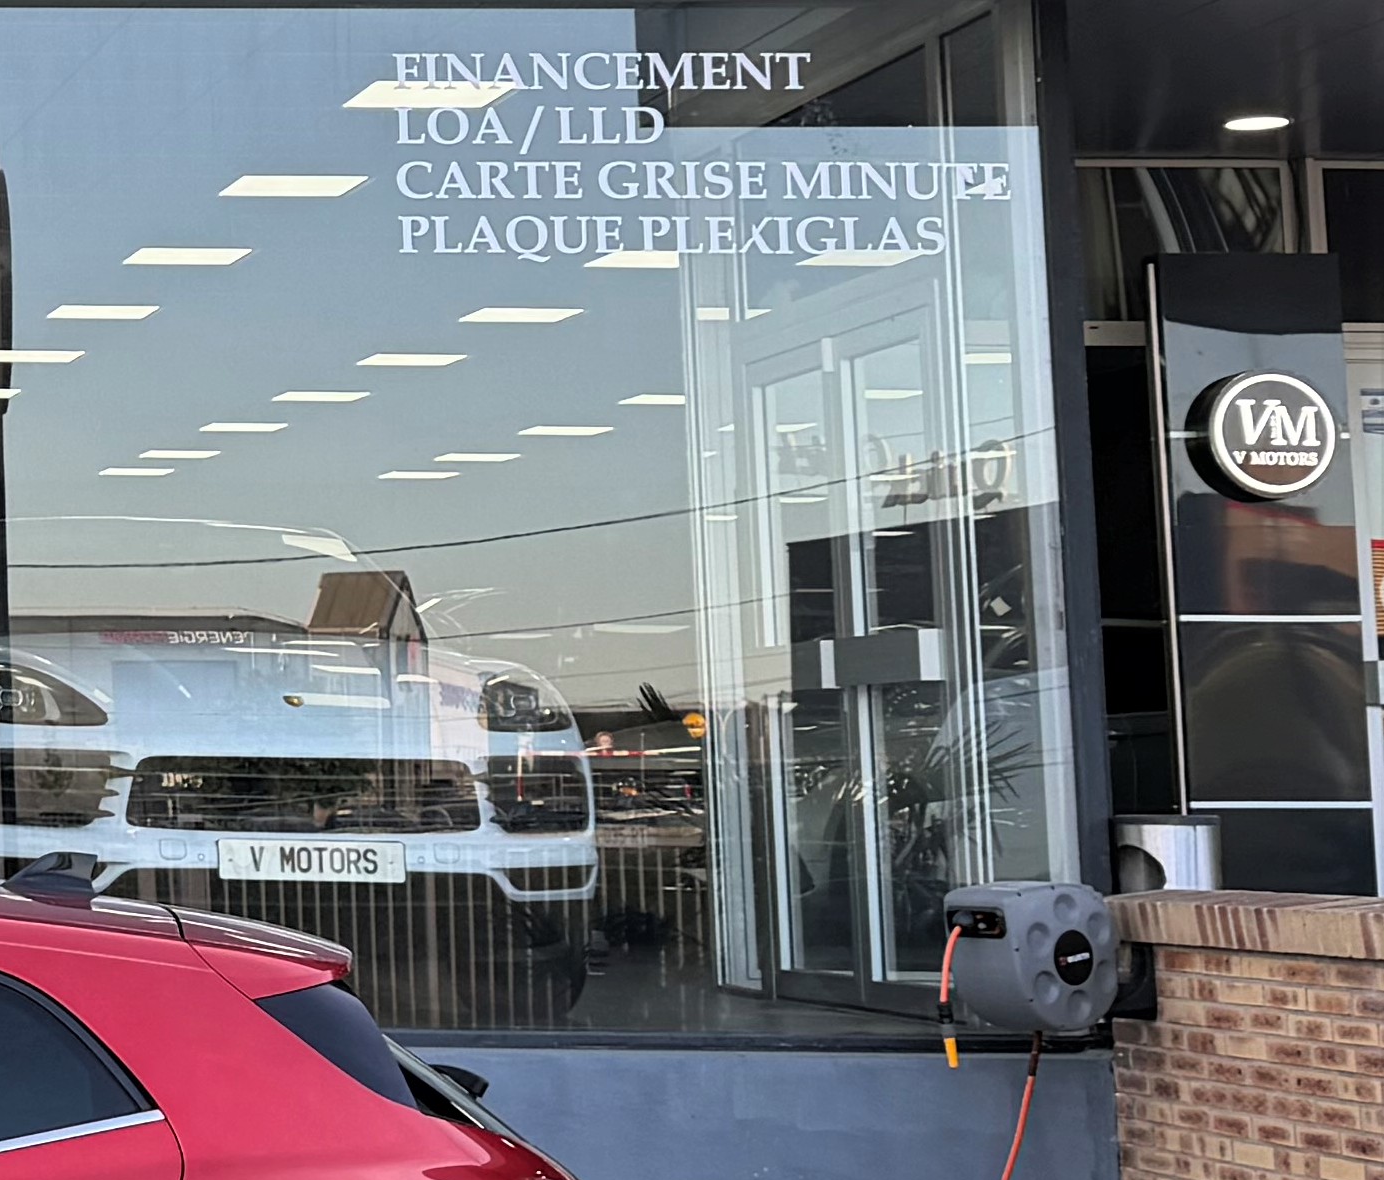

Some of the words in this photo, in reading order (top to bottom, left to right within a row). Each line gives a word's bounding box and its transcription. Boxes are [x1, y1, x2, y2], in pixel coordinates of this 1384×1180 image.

[392, 51, 812, 91] FINANCEMENT
[396, 160, 583, 201] CARTE
[598, 160, 768, 201] GRISE
[782, 161, 1012, 201] MINUTE
[398, 215, 624, 263] PLAQUE
[642, 215, 947, 256] PLEXIGLAS
[1232, 450, 1247, 465] V
[1250, 451, 1319, 467] MOTORS
[250, 846, 264, 872] V
[280, 846, 378, 875] MOTORS
